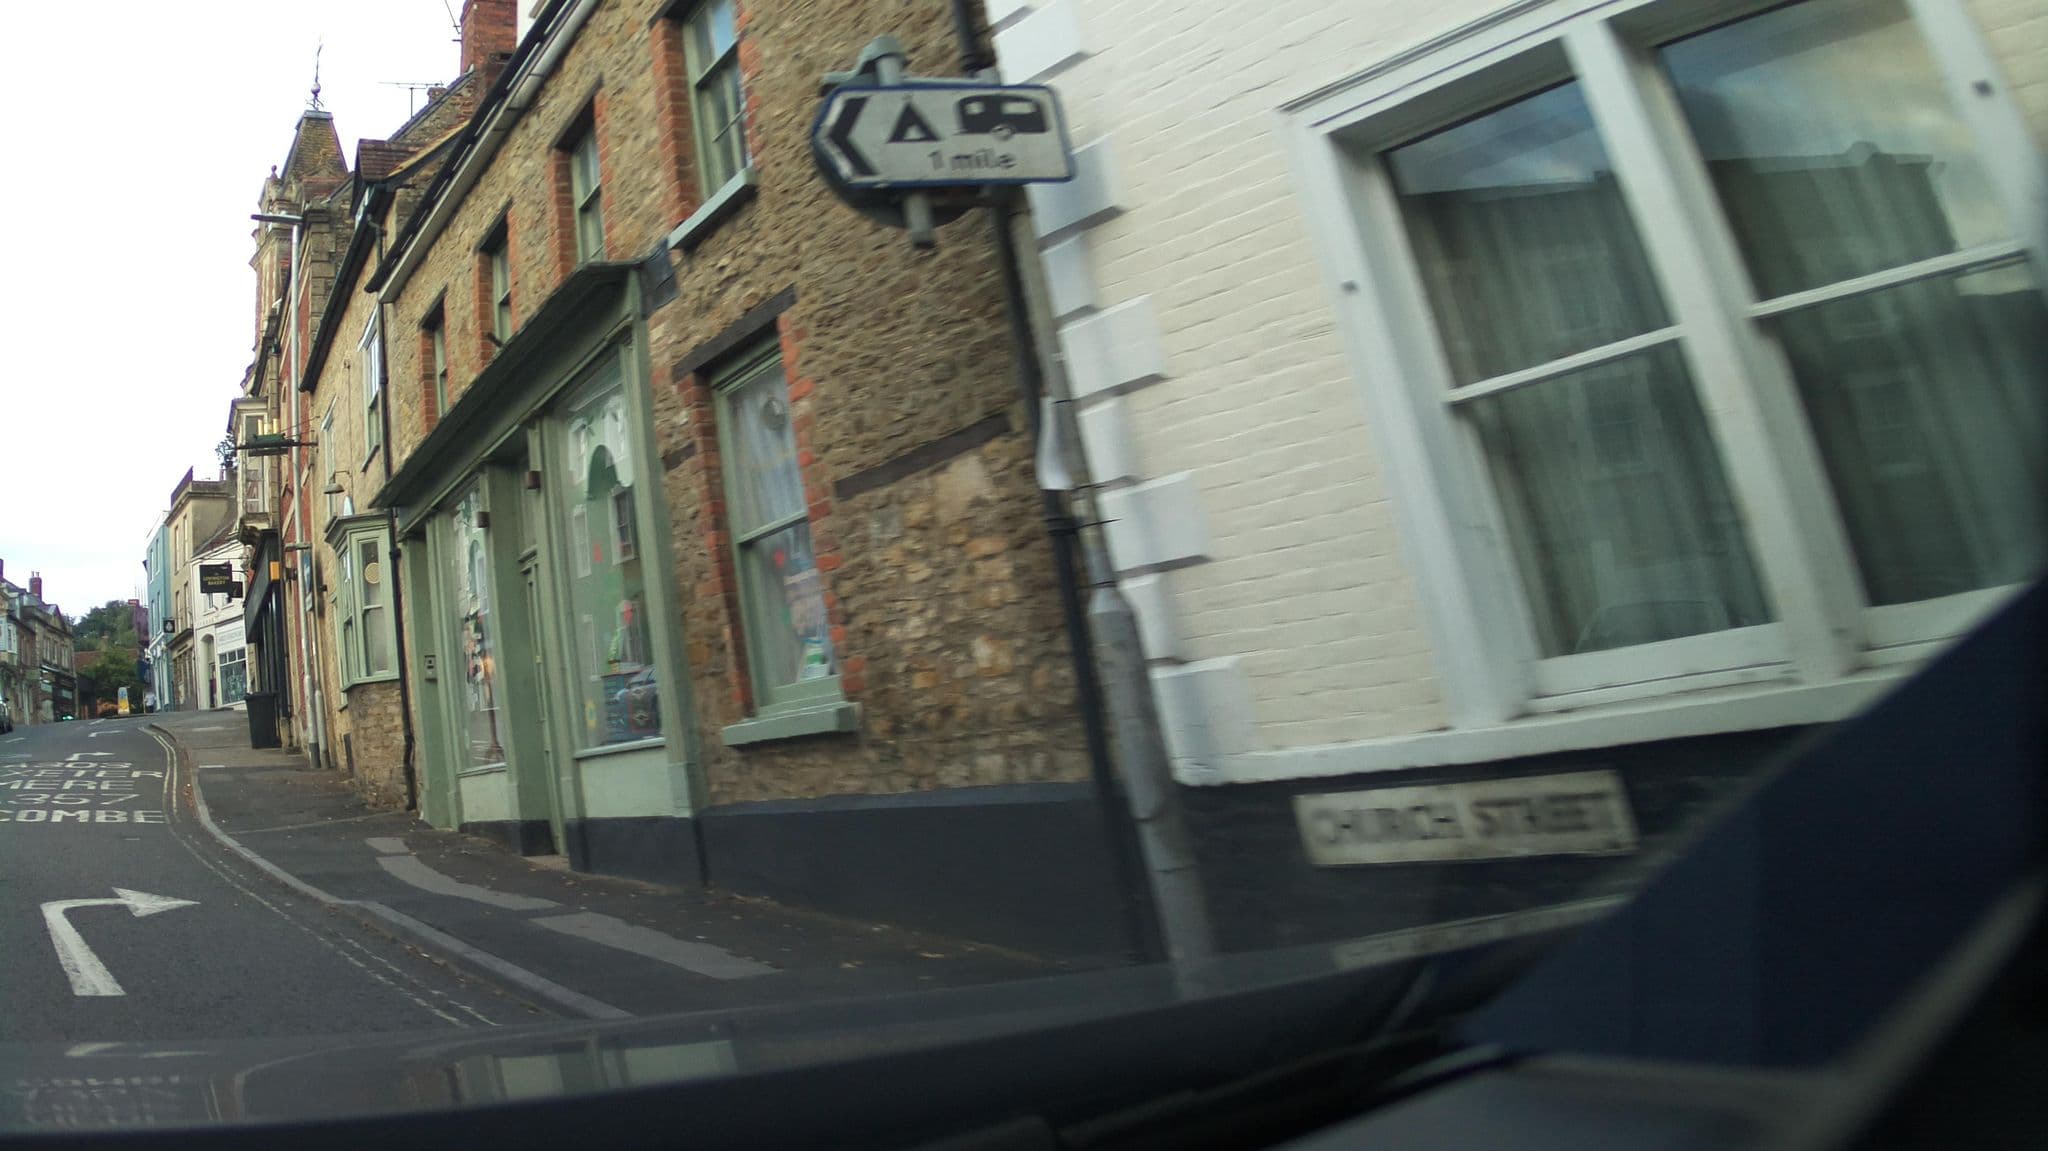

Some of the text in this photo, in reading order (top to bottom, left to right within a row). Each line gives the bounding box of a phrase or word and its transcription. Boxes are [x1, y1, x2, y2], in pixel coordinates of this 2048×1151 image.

[928, 145, 1017, 172] 1 mile
[1313, 791, 1618, 844] CHURCH STREET
